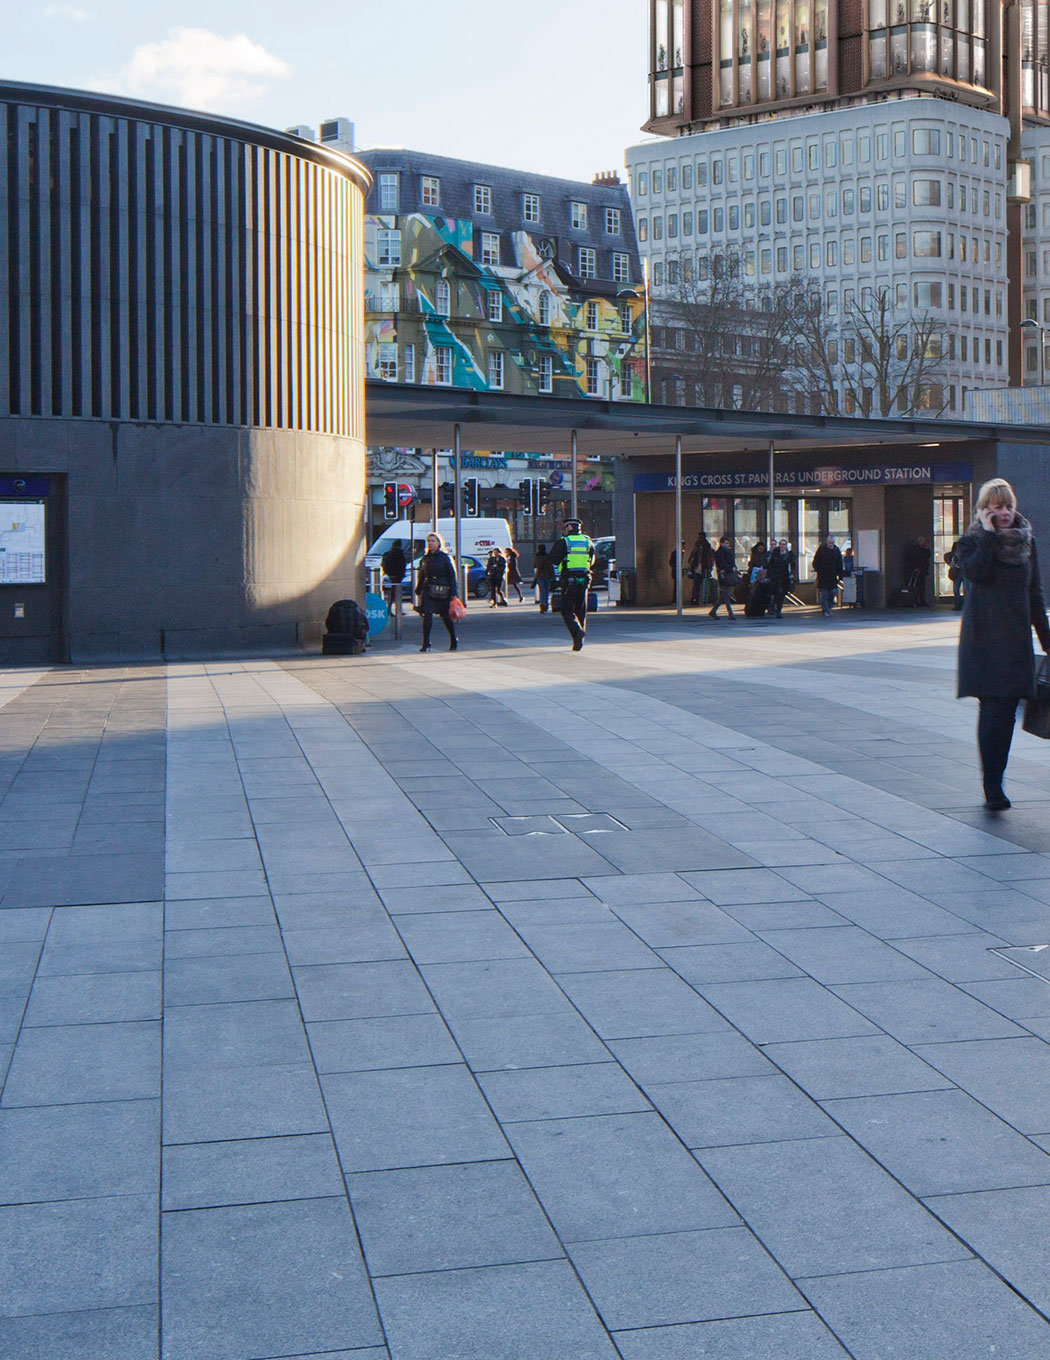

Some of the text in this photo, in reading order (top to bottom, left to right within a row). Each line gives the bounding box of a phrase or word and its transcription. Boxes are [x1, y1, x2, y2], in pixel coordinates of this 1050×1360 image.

[462, 457, 507, 469] BARCLAYS
[701, 474, 732, 485] CROSS
[749, 472, 795, 484] PANRAS
[798, 469, 881, 482] UNDERGROUND
[885, 467, 931, 479] STATION
